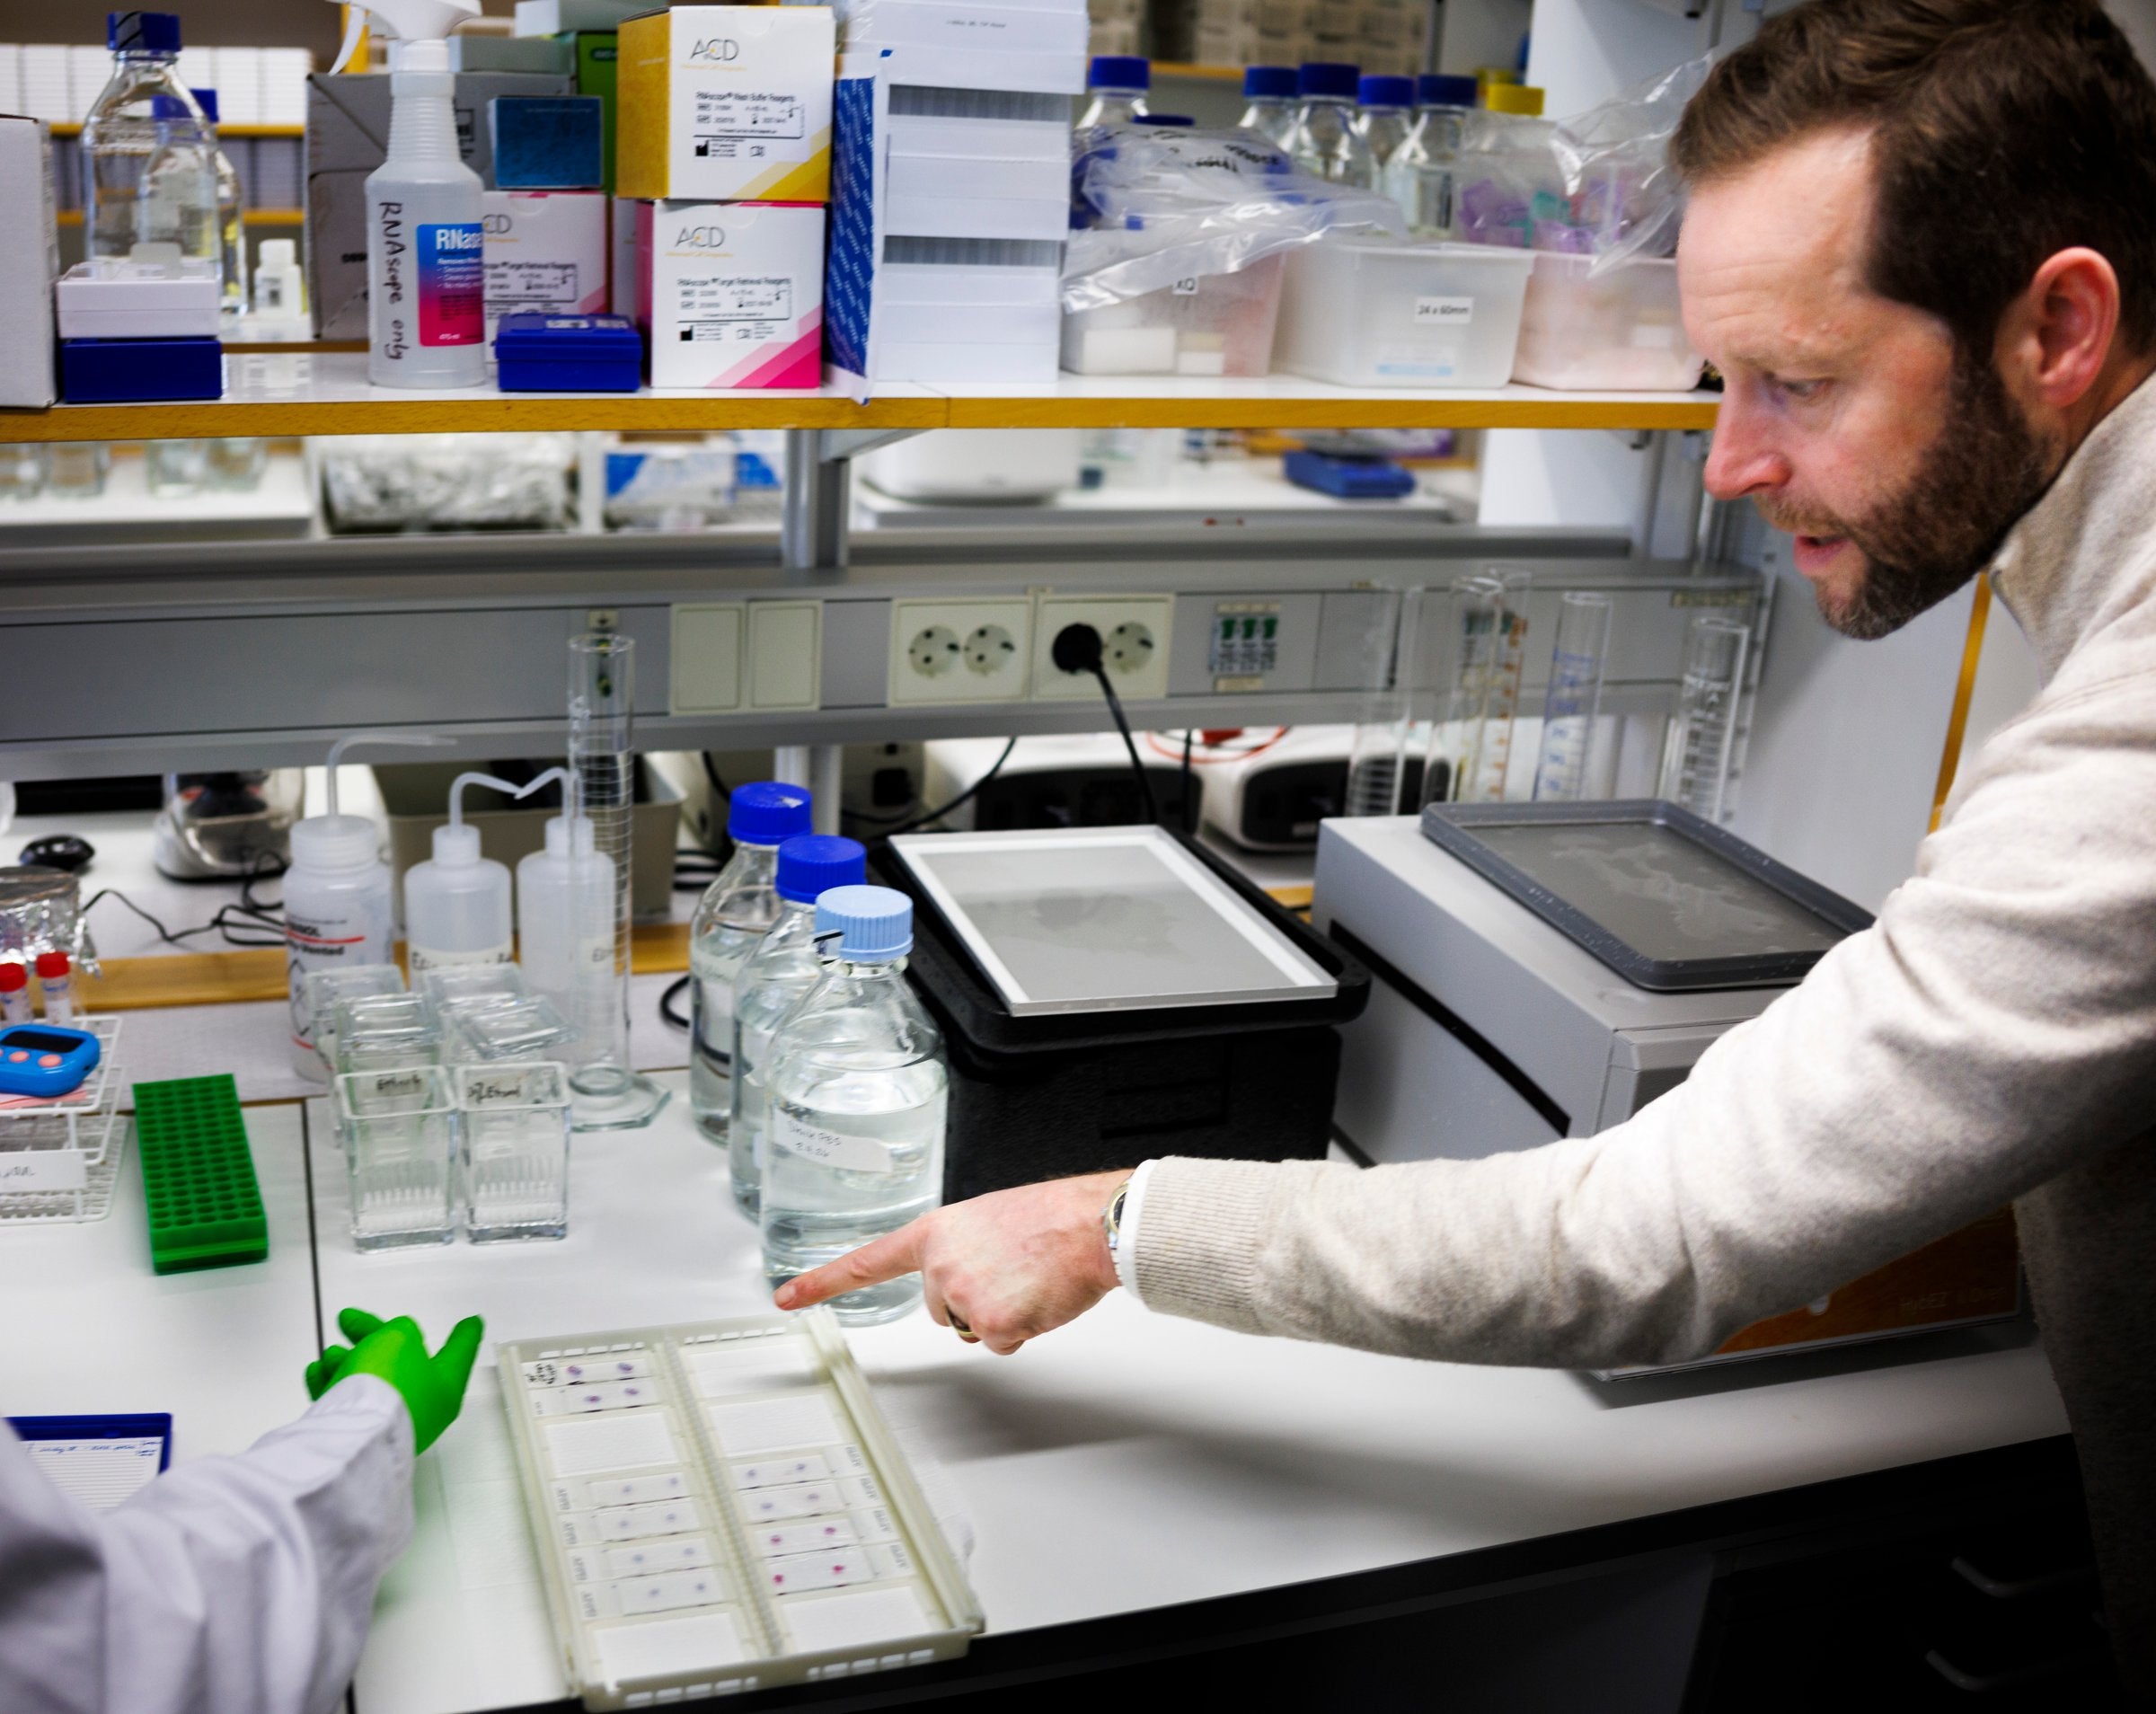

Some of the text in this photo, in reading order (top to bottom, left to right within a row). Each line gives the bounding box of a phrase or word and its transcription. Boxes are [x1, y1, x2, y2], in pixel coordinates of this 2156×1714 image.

[690, 39, 739, 60] ACD
[482, 214, 512, 234] CD
[675, 226, 725, 248] ACD
[384, 319, 410, 360] only
